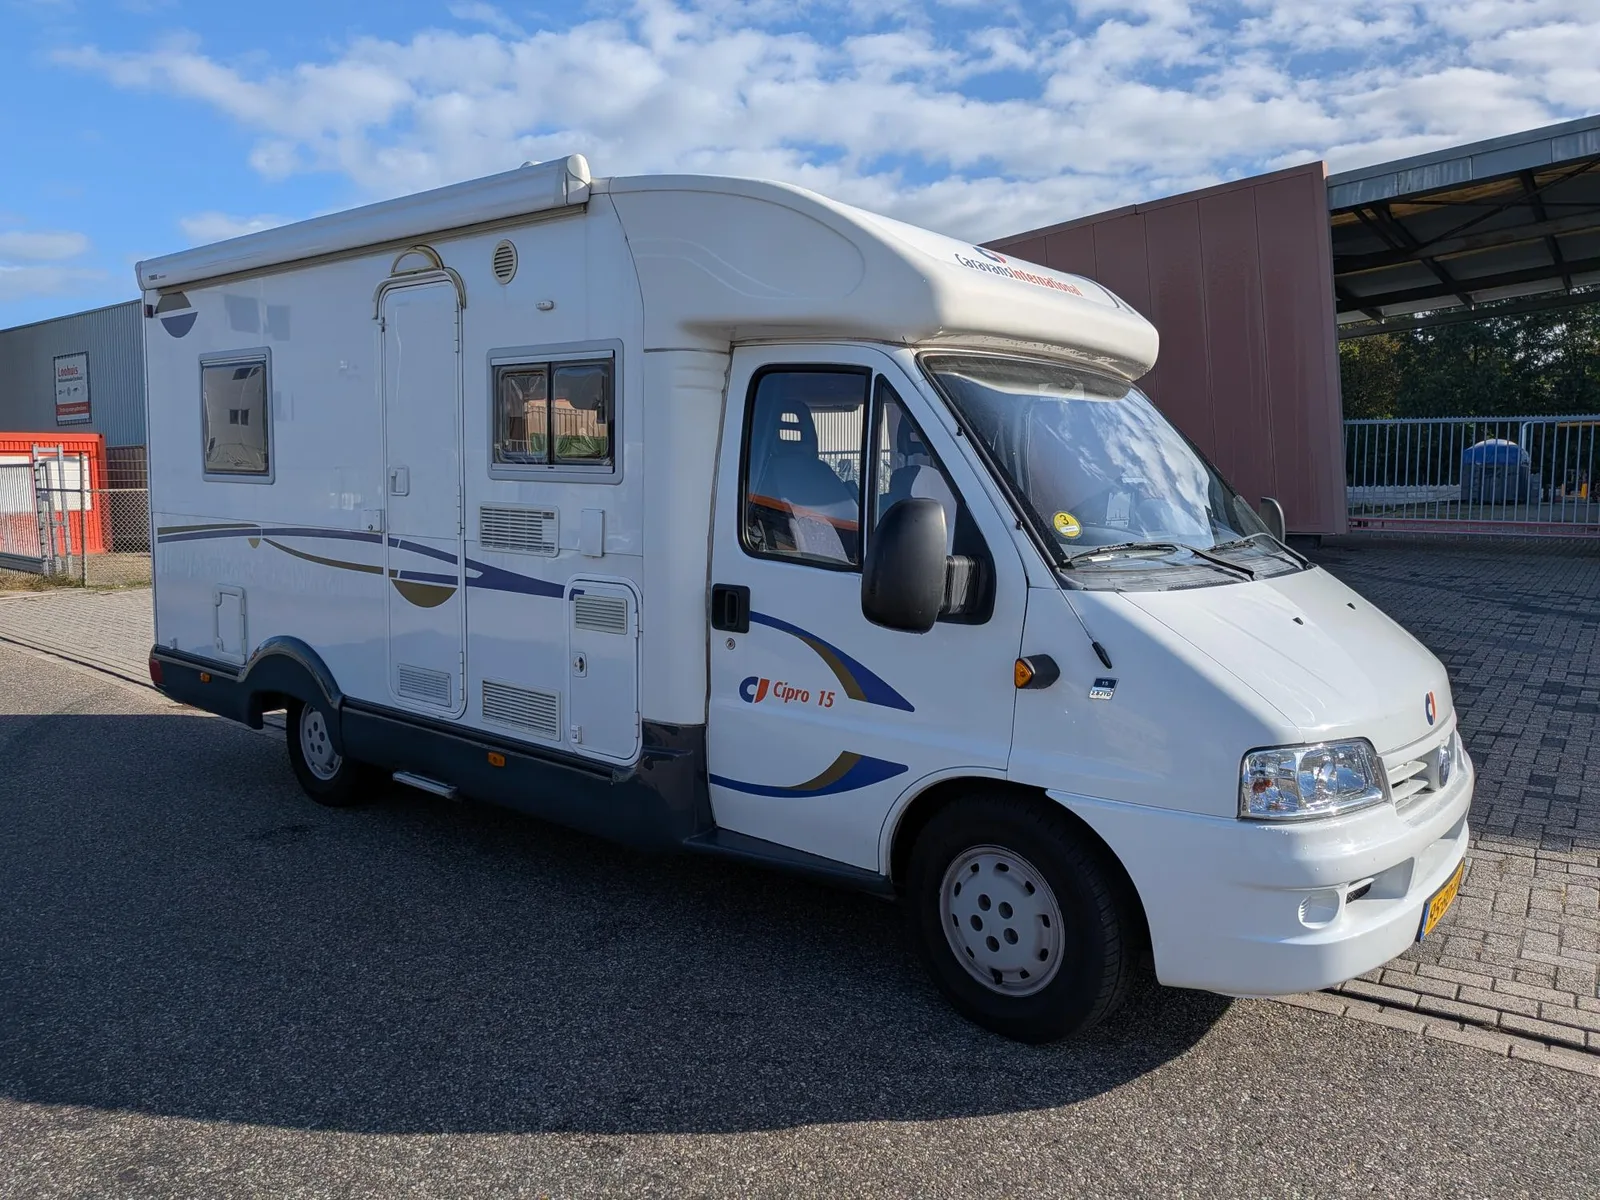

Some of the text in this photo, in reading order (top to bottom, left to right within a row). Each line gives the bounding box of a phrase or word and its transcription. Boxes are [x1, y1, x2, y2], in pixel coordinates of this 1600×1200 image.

[1059, 514, 1070, 526] 3
[772, 681, 810, 704] Cipro
[817, 690, 836, 708] 15
